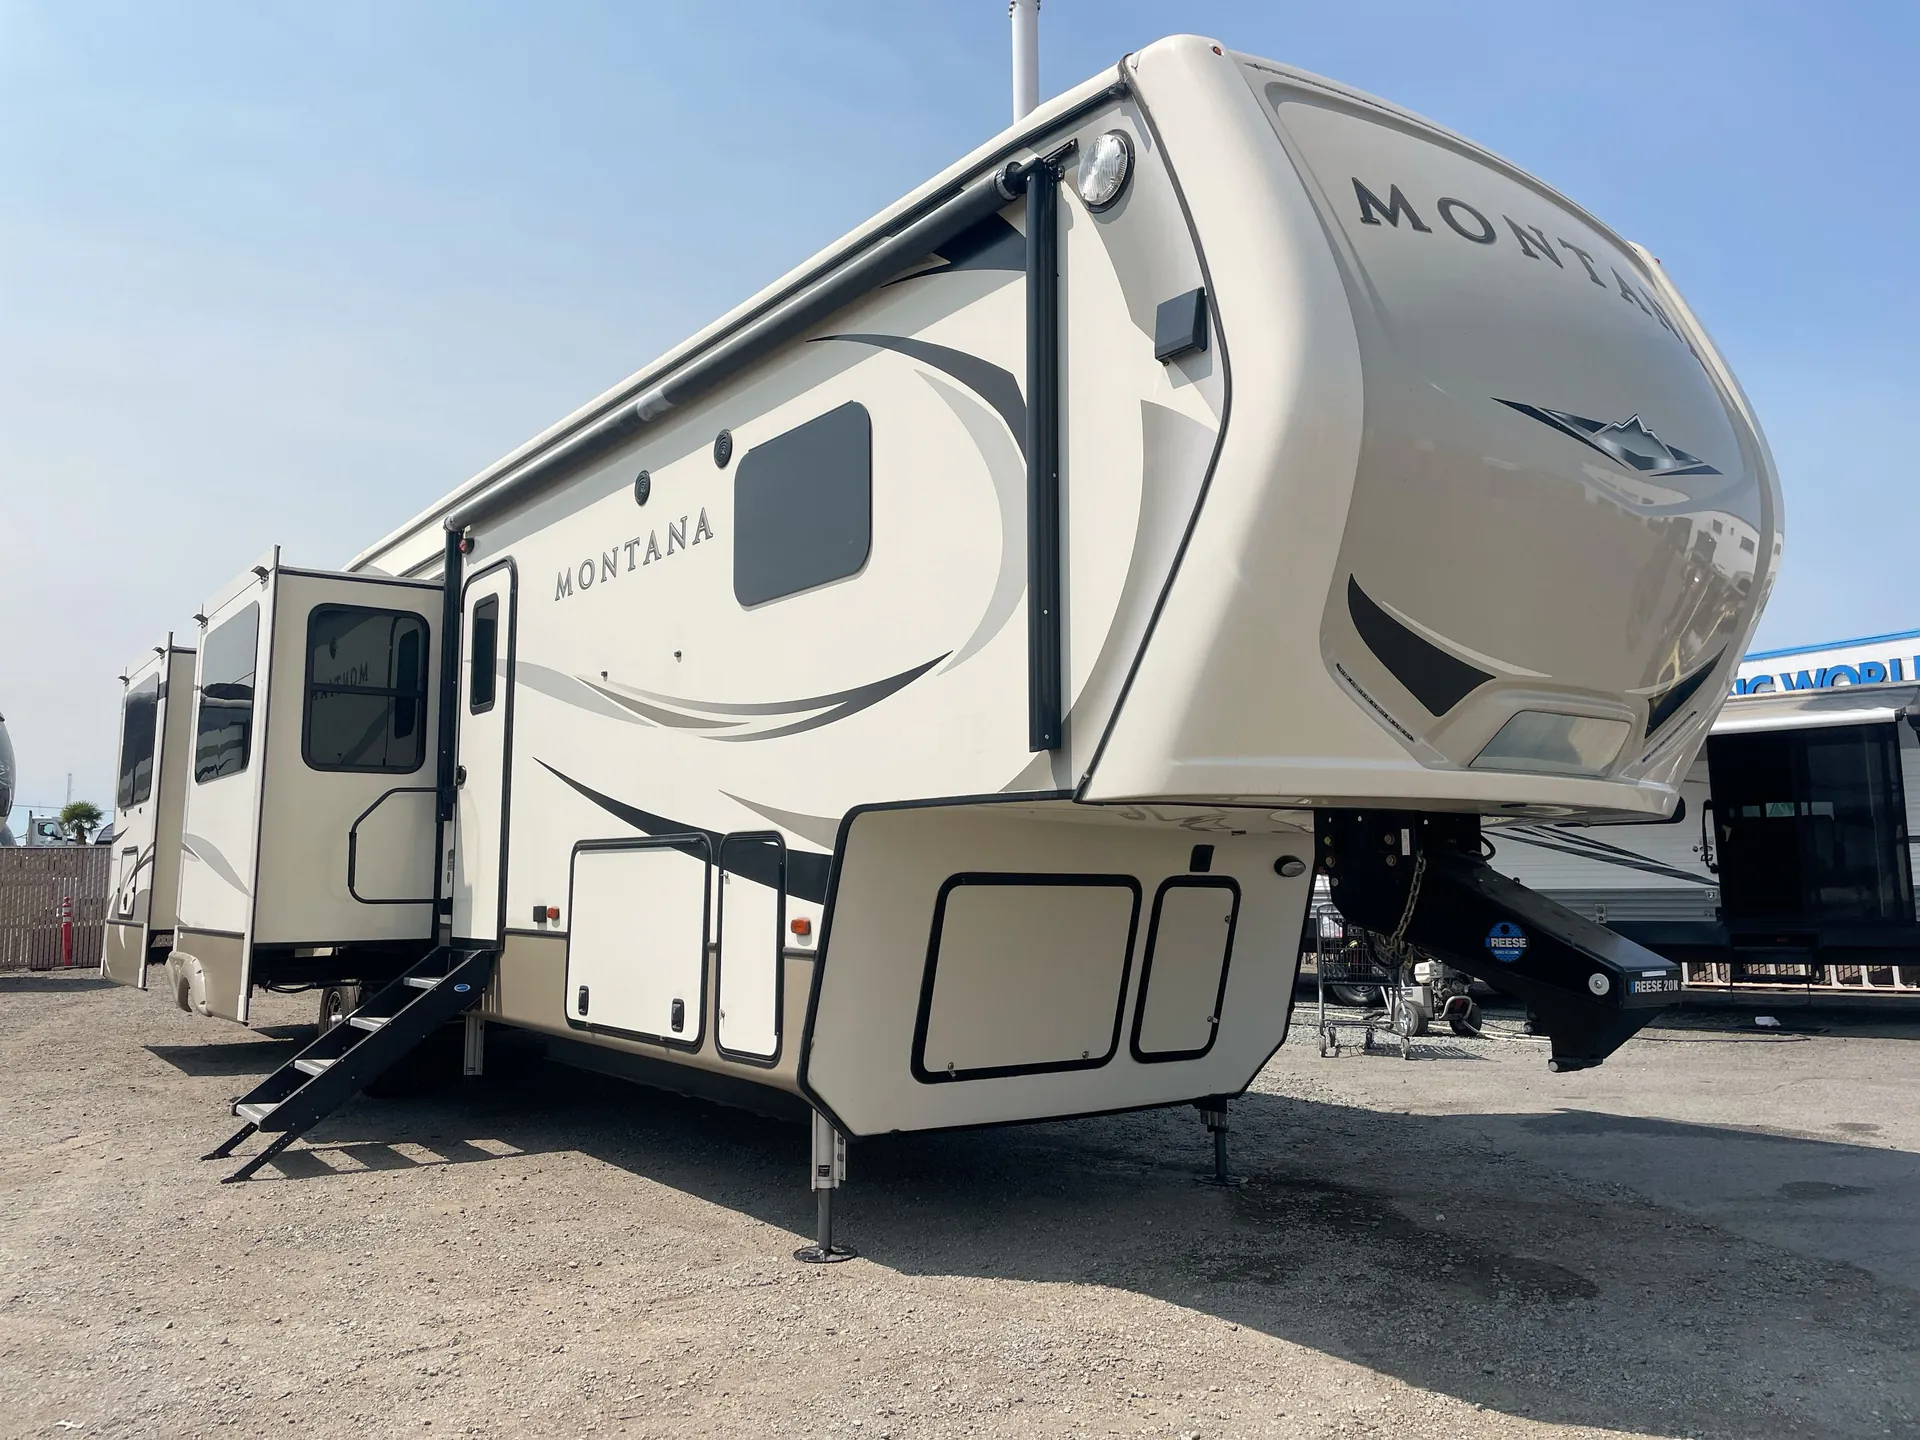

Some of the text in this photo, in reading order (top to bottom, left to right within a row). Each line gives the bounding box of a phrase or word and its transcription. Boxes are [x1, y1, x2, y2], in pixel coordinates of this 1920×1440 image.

[1351, 177, 1701, 360] MONTAN
[555, 507, 713, 601] MONTANA
[1779, 655, 1920, 691] WOR
[1490, 937, 1527, 948] REESE
[1634, 979, 1679, 993] REESE 20K
